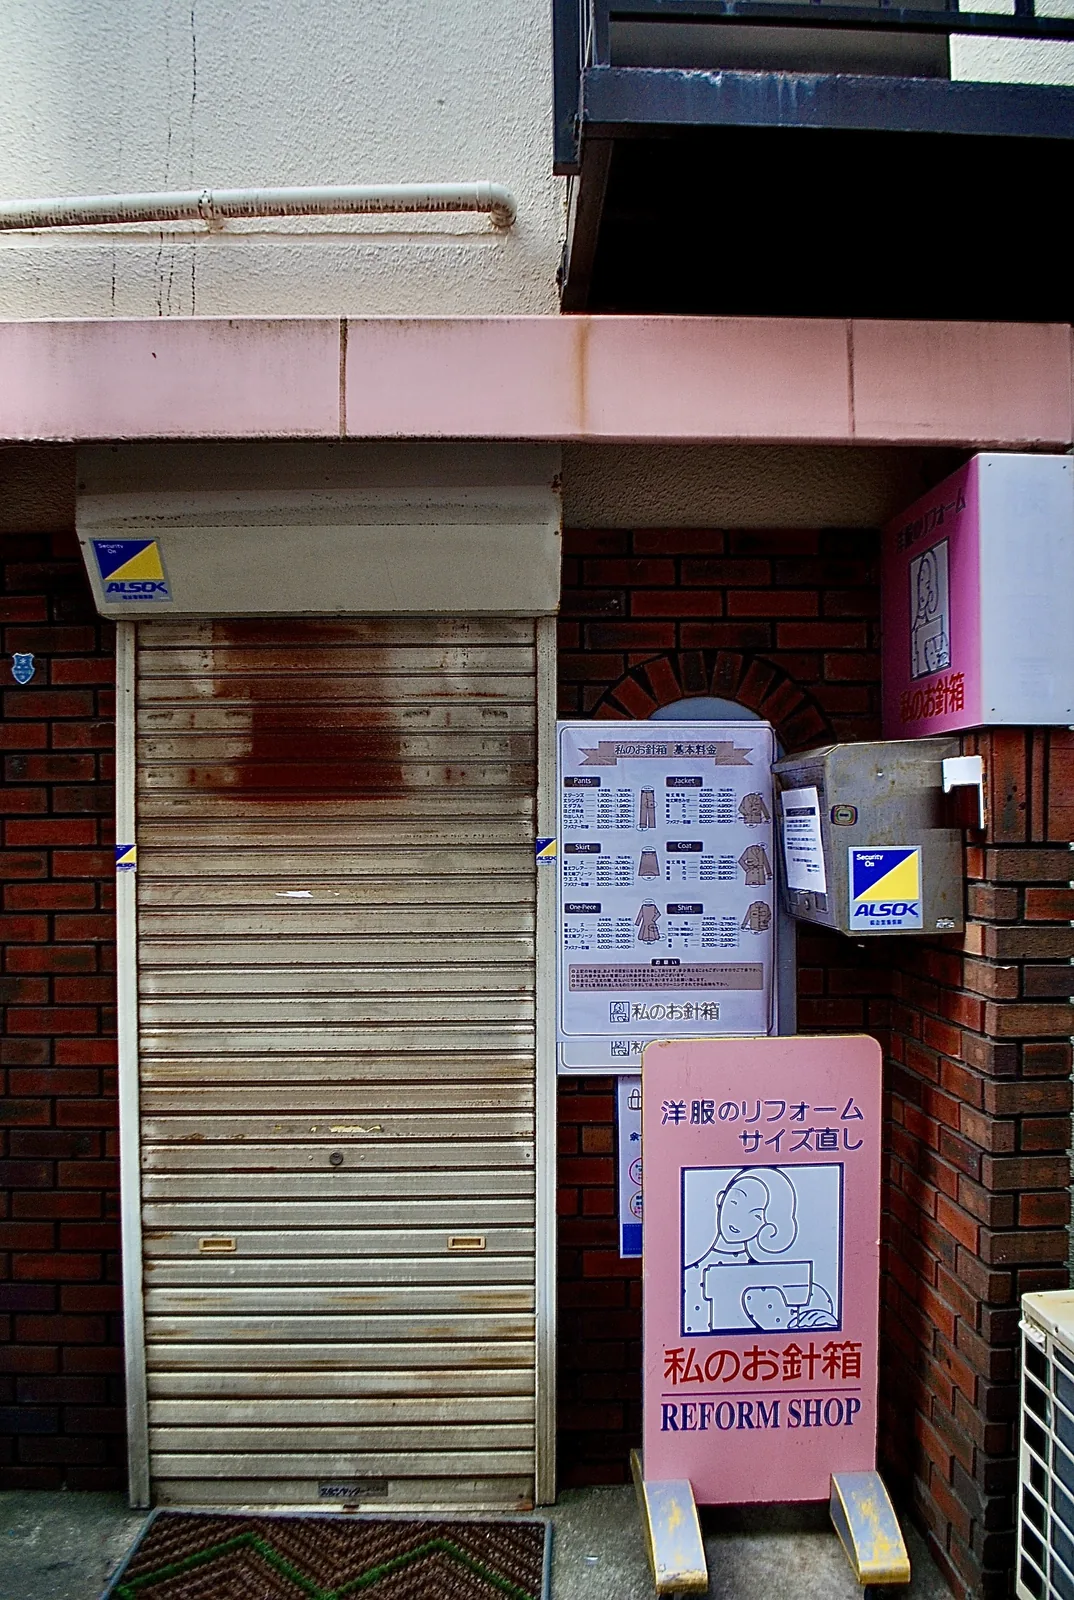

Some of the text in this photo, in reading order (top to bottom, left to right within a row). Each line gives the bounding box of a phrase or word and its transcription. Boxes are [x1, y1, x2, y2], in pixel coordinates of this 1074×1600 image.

[106, 582, 168, 594] ALSOK
[902, 672, 965, 724] 私のお針箱
[615, 743, 717, 755] 私のお針箱 基本料金
[856, 853, 884, 861] Security
[854, 903, 919, 917] ALSOK
[631, 1002, 720, 1021] 私のお針箱
[661, 1097, 865, 1126] 洋服のリフォーム
[738, 1129, 863, 1153] サイズ直し
[663, 1340, 862, 1385] 私のお針箱
[660, 1397, 862, 1431] REFORM SHOP
